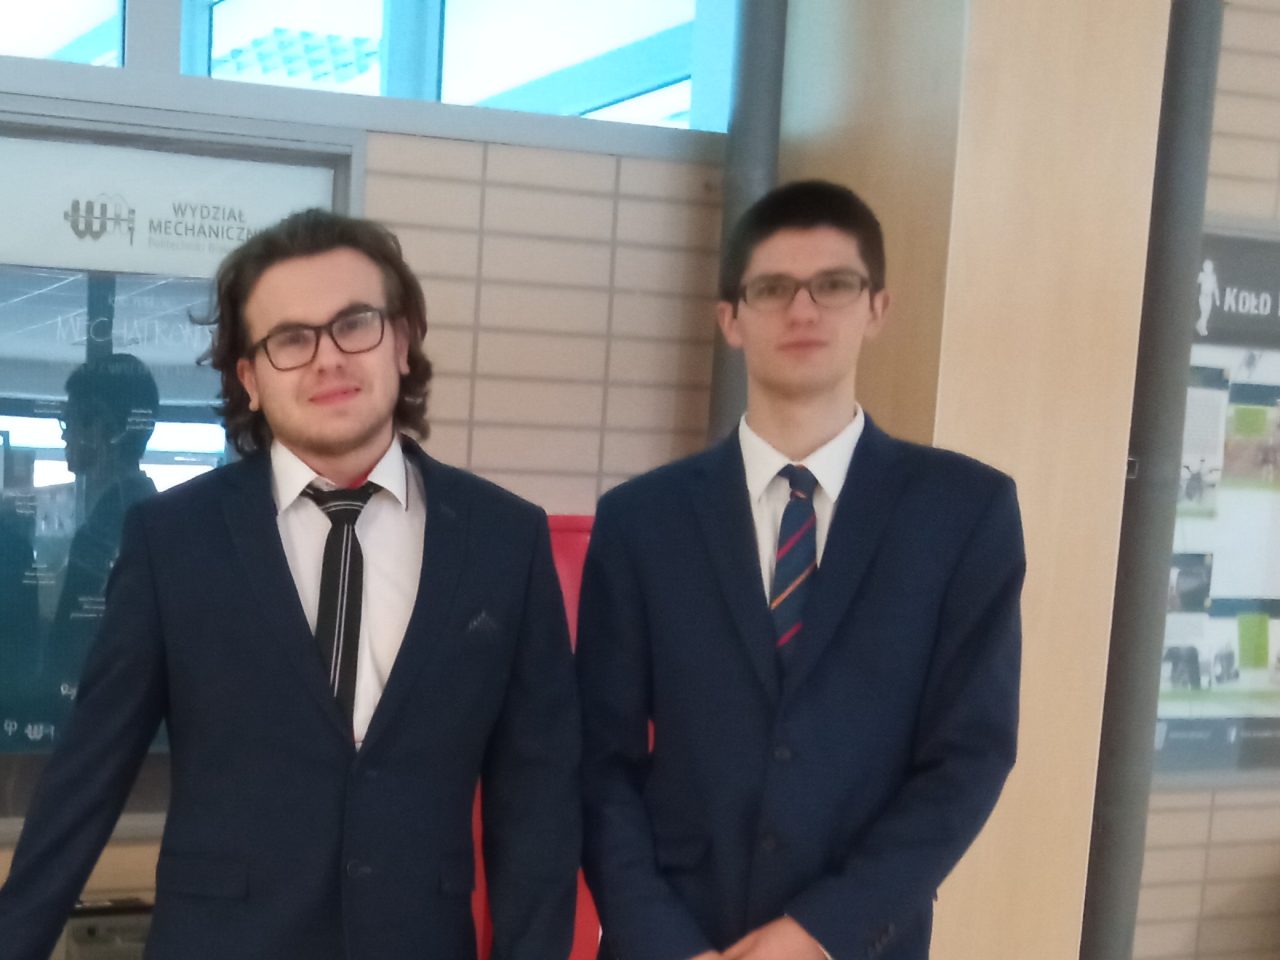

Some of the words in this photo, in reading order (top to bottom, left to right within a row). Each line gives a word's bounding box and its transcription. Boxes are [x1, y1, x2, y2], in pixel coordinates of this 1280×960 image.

[173, 202, 247, 223] WYDZIAŁ
[149, 219, 261, 242] MECHANICZN
[1223, 287, 1271, 316] KOŁO
